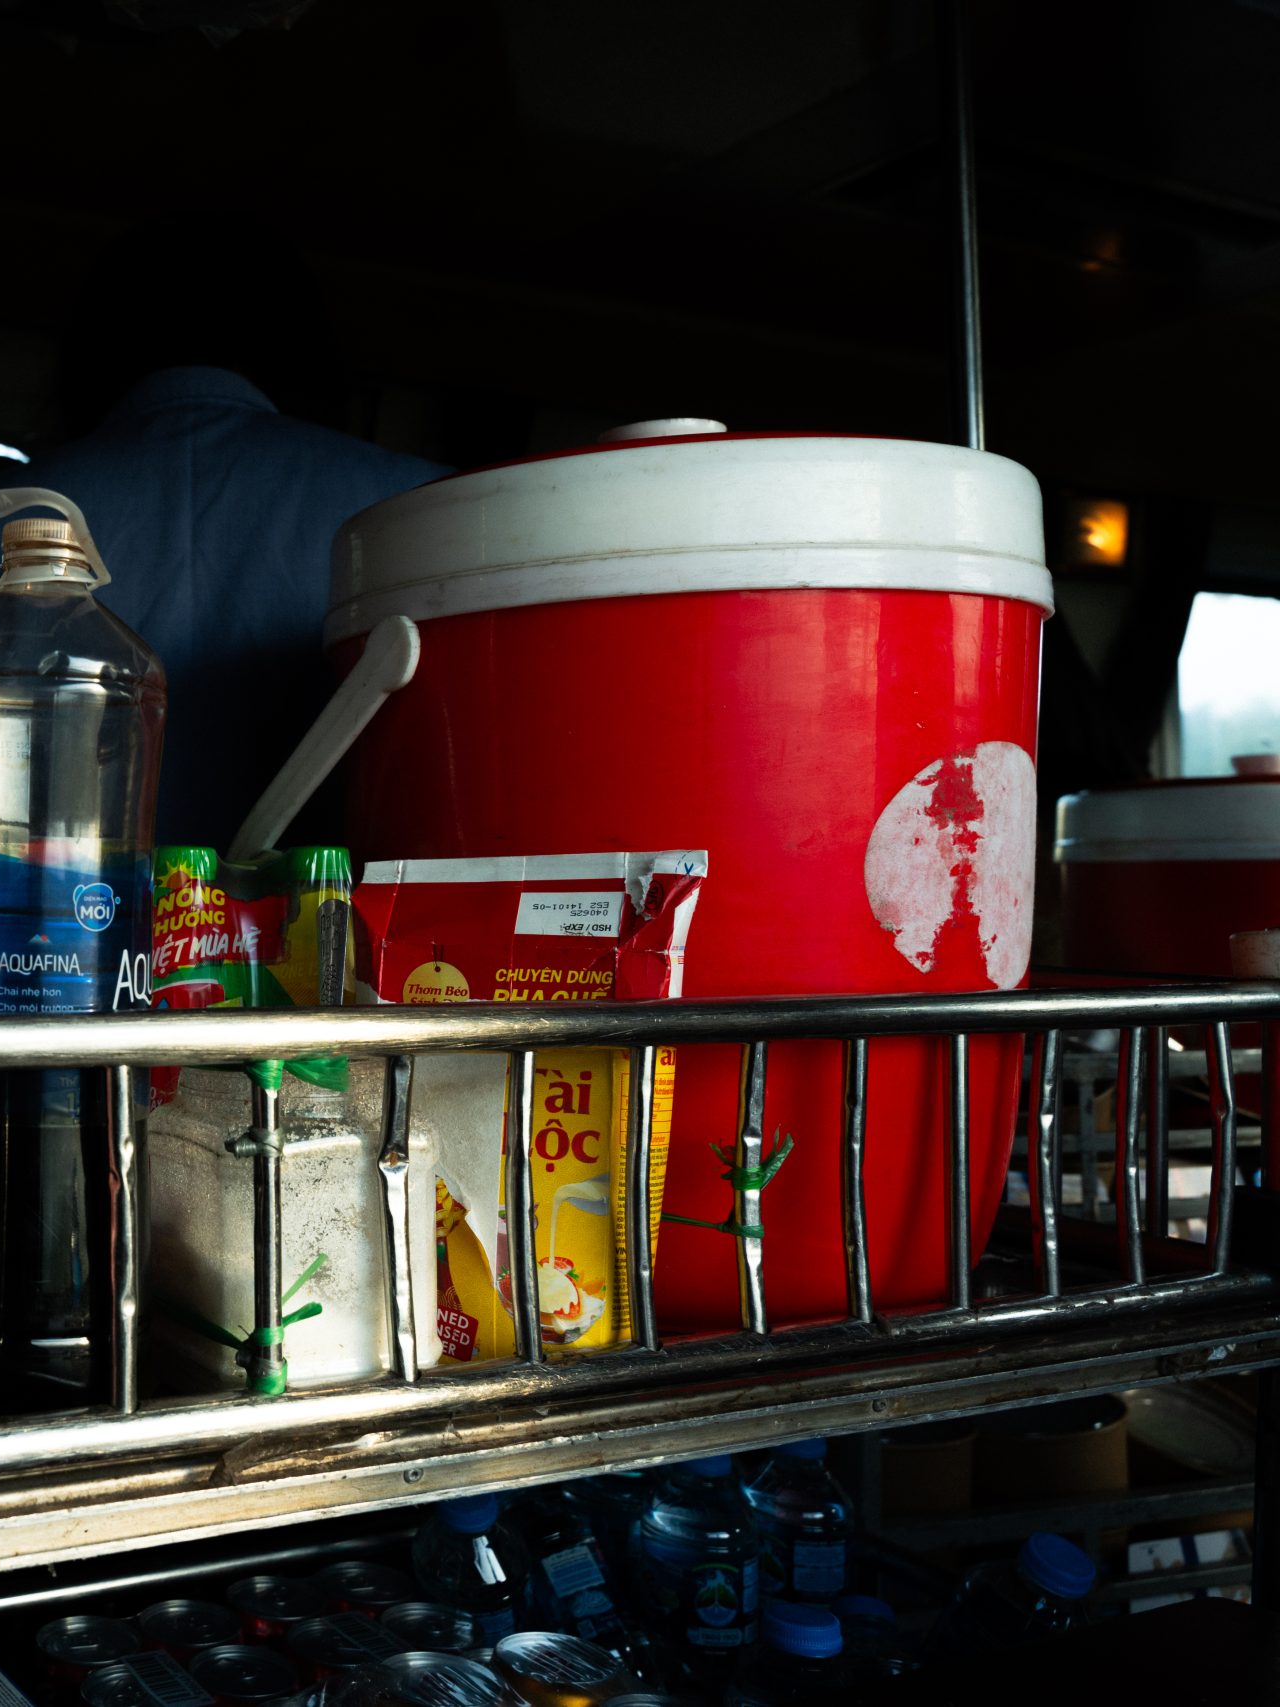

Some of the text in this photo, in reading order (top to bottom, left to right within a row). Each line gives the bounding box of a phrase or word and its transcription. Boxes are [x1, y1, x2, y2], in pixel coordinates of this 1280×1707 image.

[157, 881, 225, 916] NÓNG
[80, 903, 110, 919] MỚI
[570, 909, 609, 917] 040625
[153, 906, 225, 936] HƯỞNG
[189, 927, 228, 960] MÙA
[232, 927, 261, 953] HÈ
[495, 967, 613, 984] CHUYÊN DÙNG
[21, 987, 40, 997] nhẹ
[42, 987, 62, 997] hơn
[408, 984, 468, 997] Thơm Béo
[20, 1003, 38, 1012] môi
